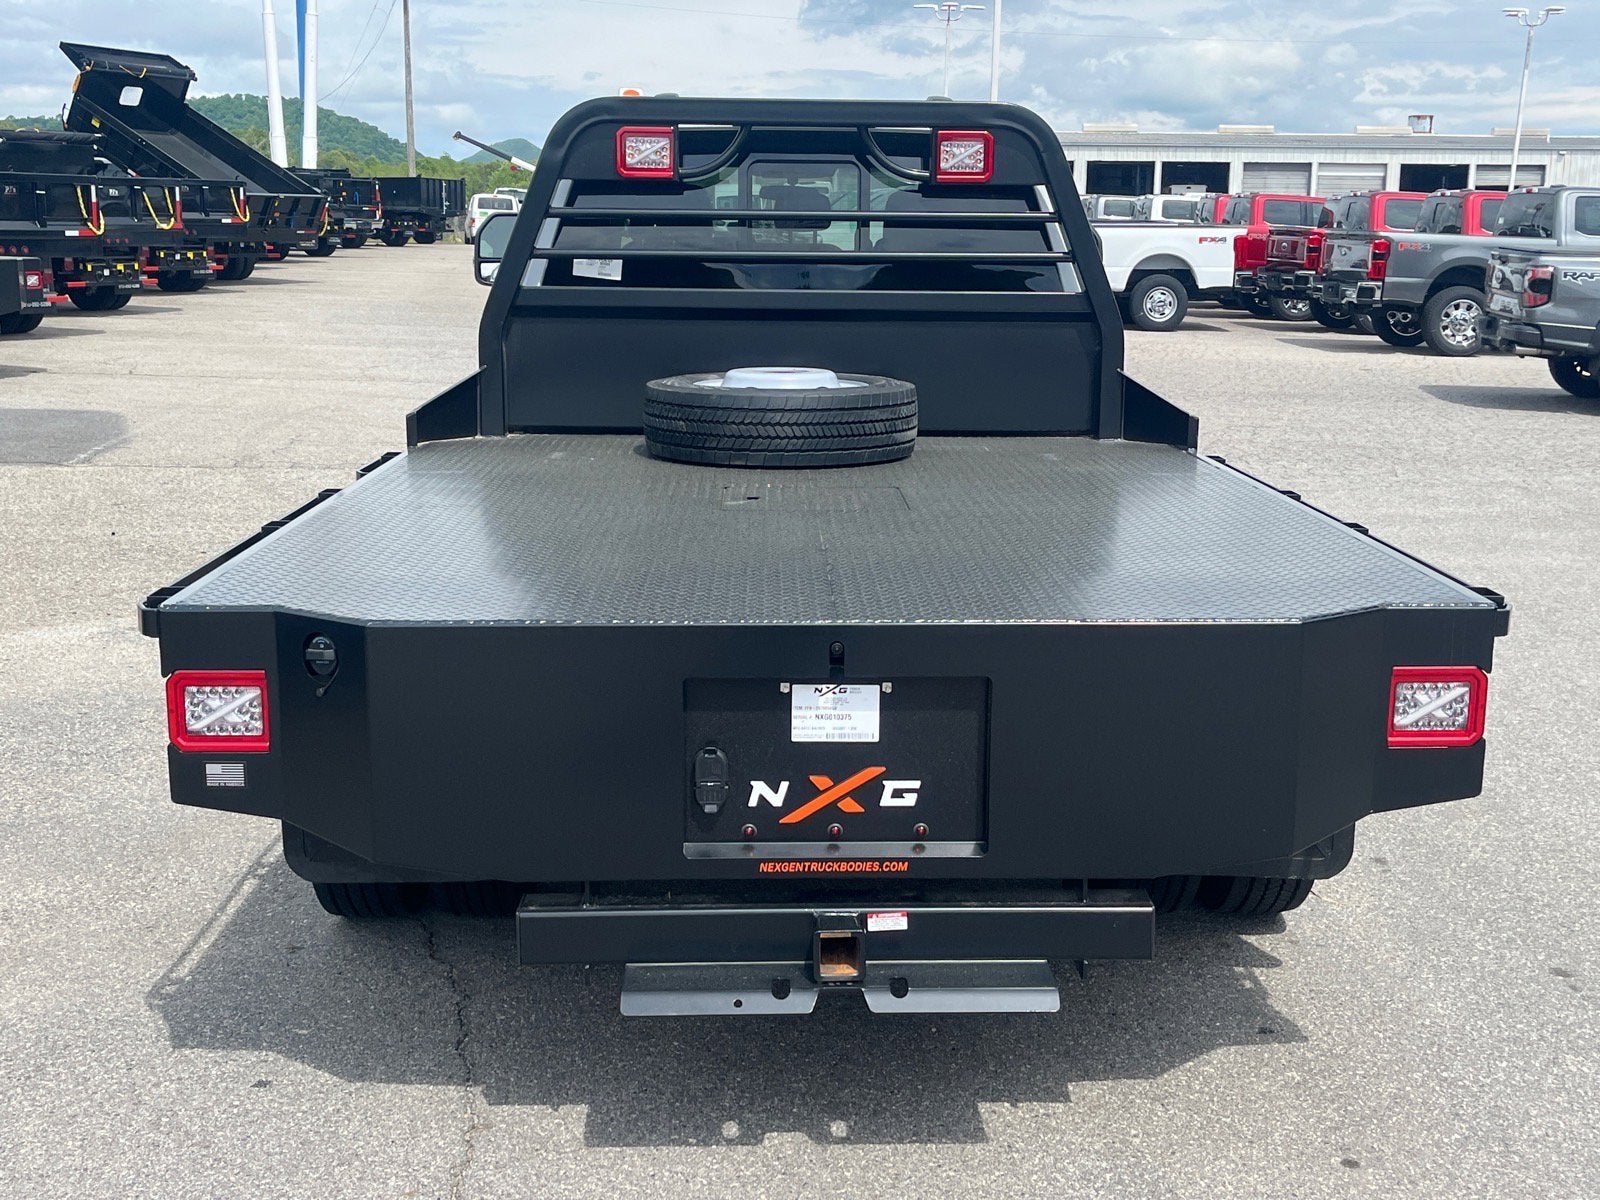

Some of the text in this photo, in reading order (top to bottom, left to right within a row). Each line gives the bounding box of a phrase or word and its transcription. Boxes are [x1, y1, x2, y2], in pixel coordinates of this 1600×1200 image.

[1198, 236, 1227, 244] FX4
[813, 684, 848, 697] NXG
[748, 766, 922, 824] NXG
[759, 862, 909, 872] NEXGENTRUCKBODIES.COM
